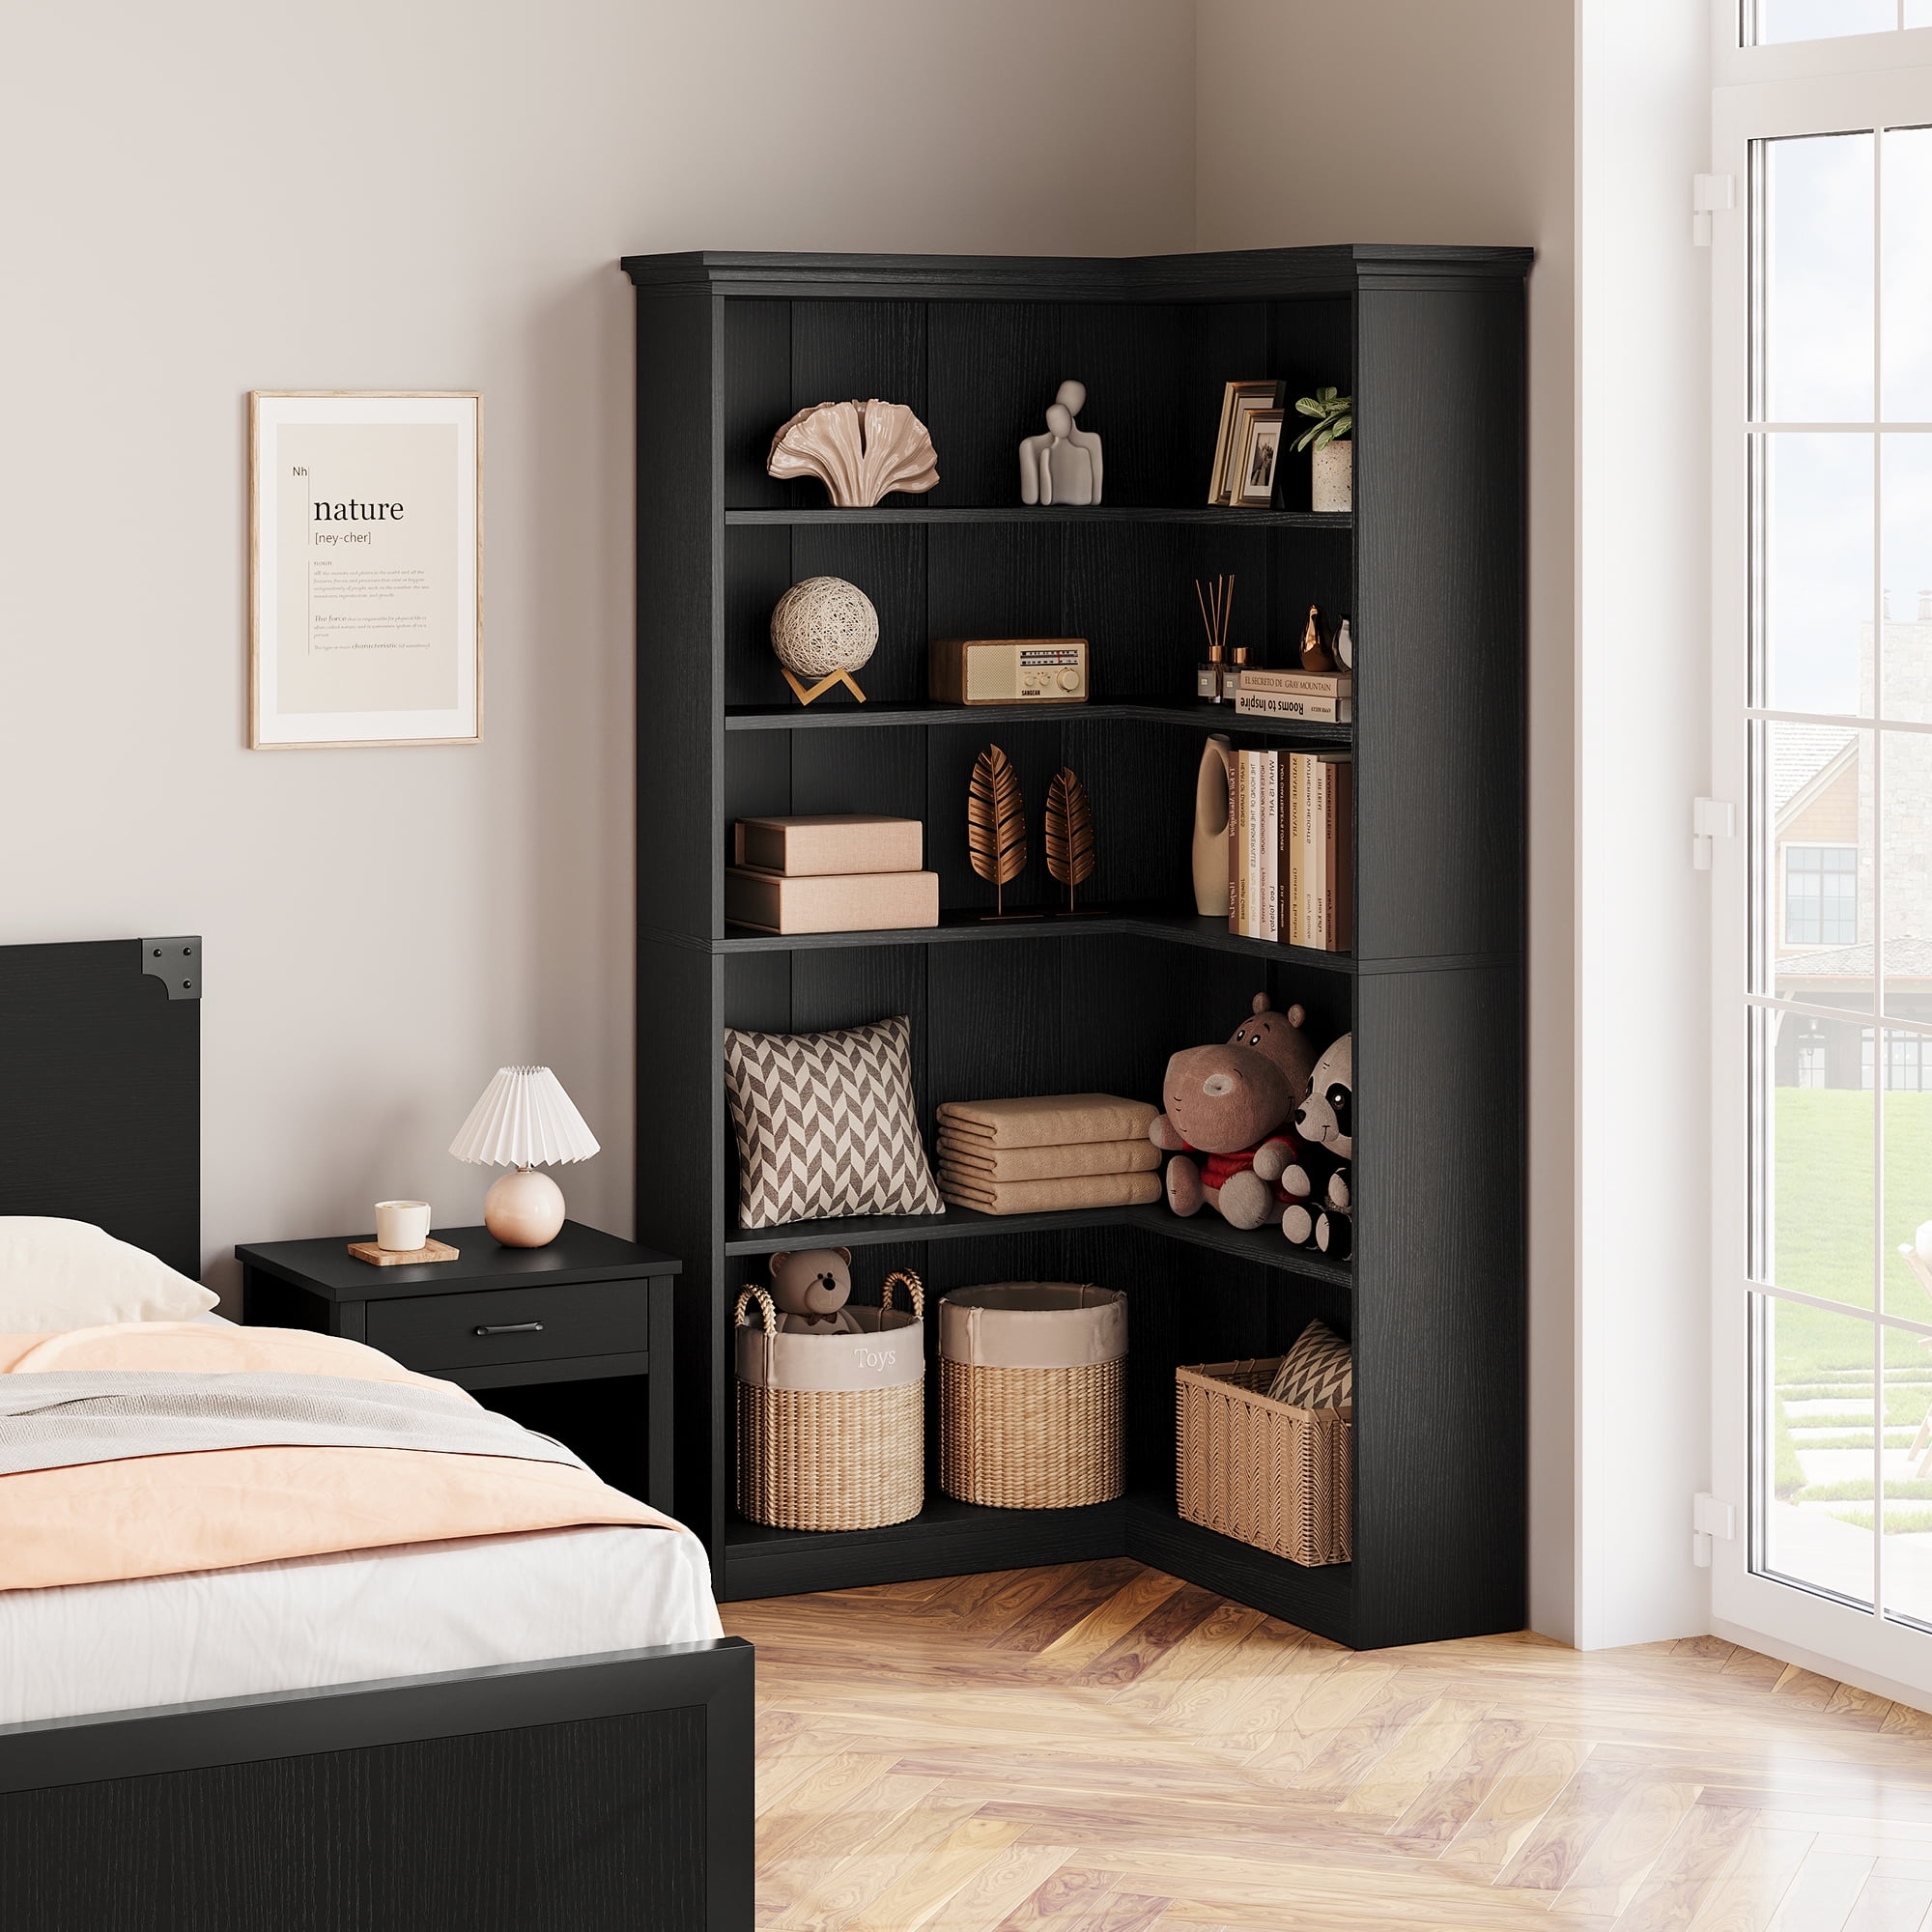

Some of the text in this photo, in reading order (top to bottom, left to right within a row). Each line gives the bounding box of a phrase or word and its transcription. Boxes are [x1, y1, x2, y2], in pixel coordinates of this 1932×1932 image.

[293, 467, 307, 476] Nh
[314, 498, 404, 521] nature
[315, 532, 371, 546] [ney-cher]
[1252, 676, 1274, 686] SECRETO
[1285, 680, 1299, 689] GRAY
[1300, 682, 1331, 691] MOUNTAIN
[1240, 696, 1303, 715] Rooms to Inspire
[854, 1349, 895, 1372] Toys
